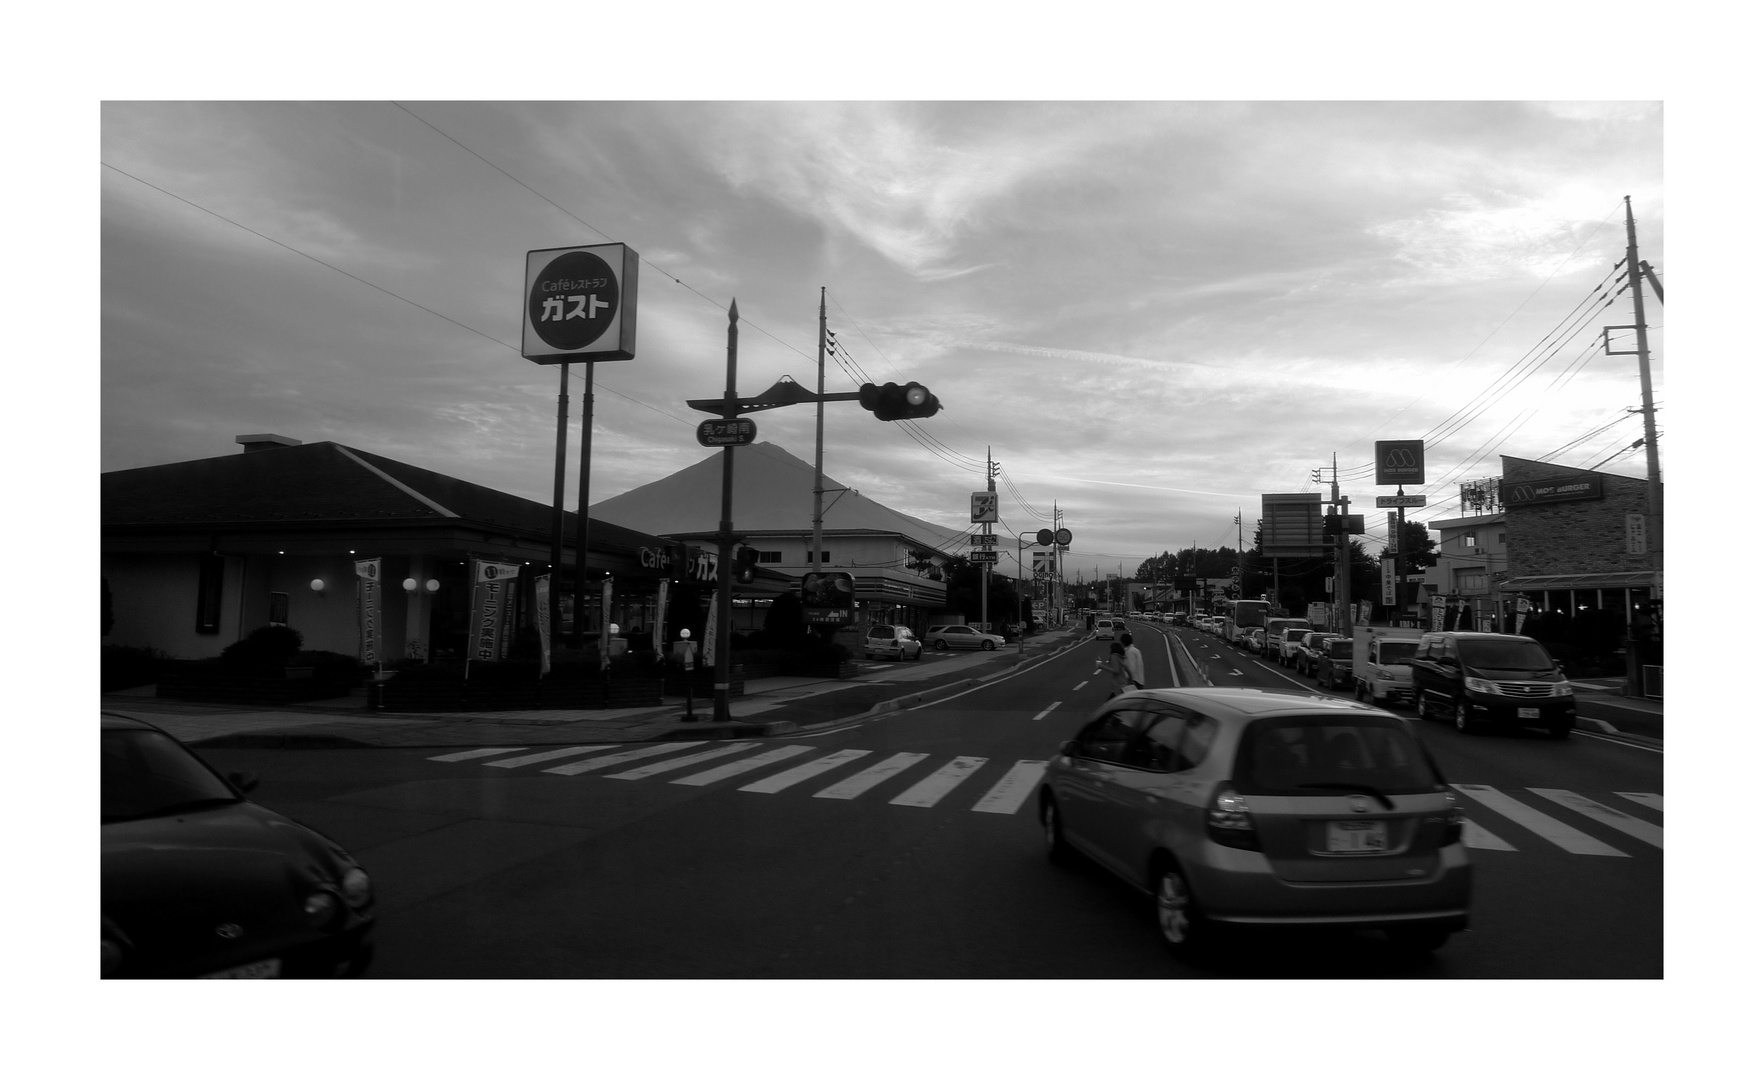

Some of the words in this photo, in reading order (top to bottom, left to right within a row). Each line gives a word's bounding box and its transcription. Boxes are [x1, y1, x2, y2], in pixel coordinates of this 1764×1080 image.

[541, 294, 609, 322] ガスト
[1535, 486, 1555, 495] MOS
[1556, 483, 1590, 493] BURGER
[696, 552, 719, 582] ガス
[478, 582, 500, 661] モーニング実施中
[839, 609, 848, 618] IN
